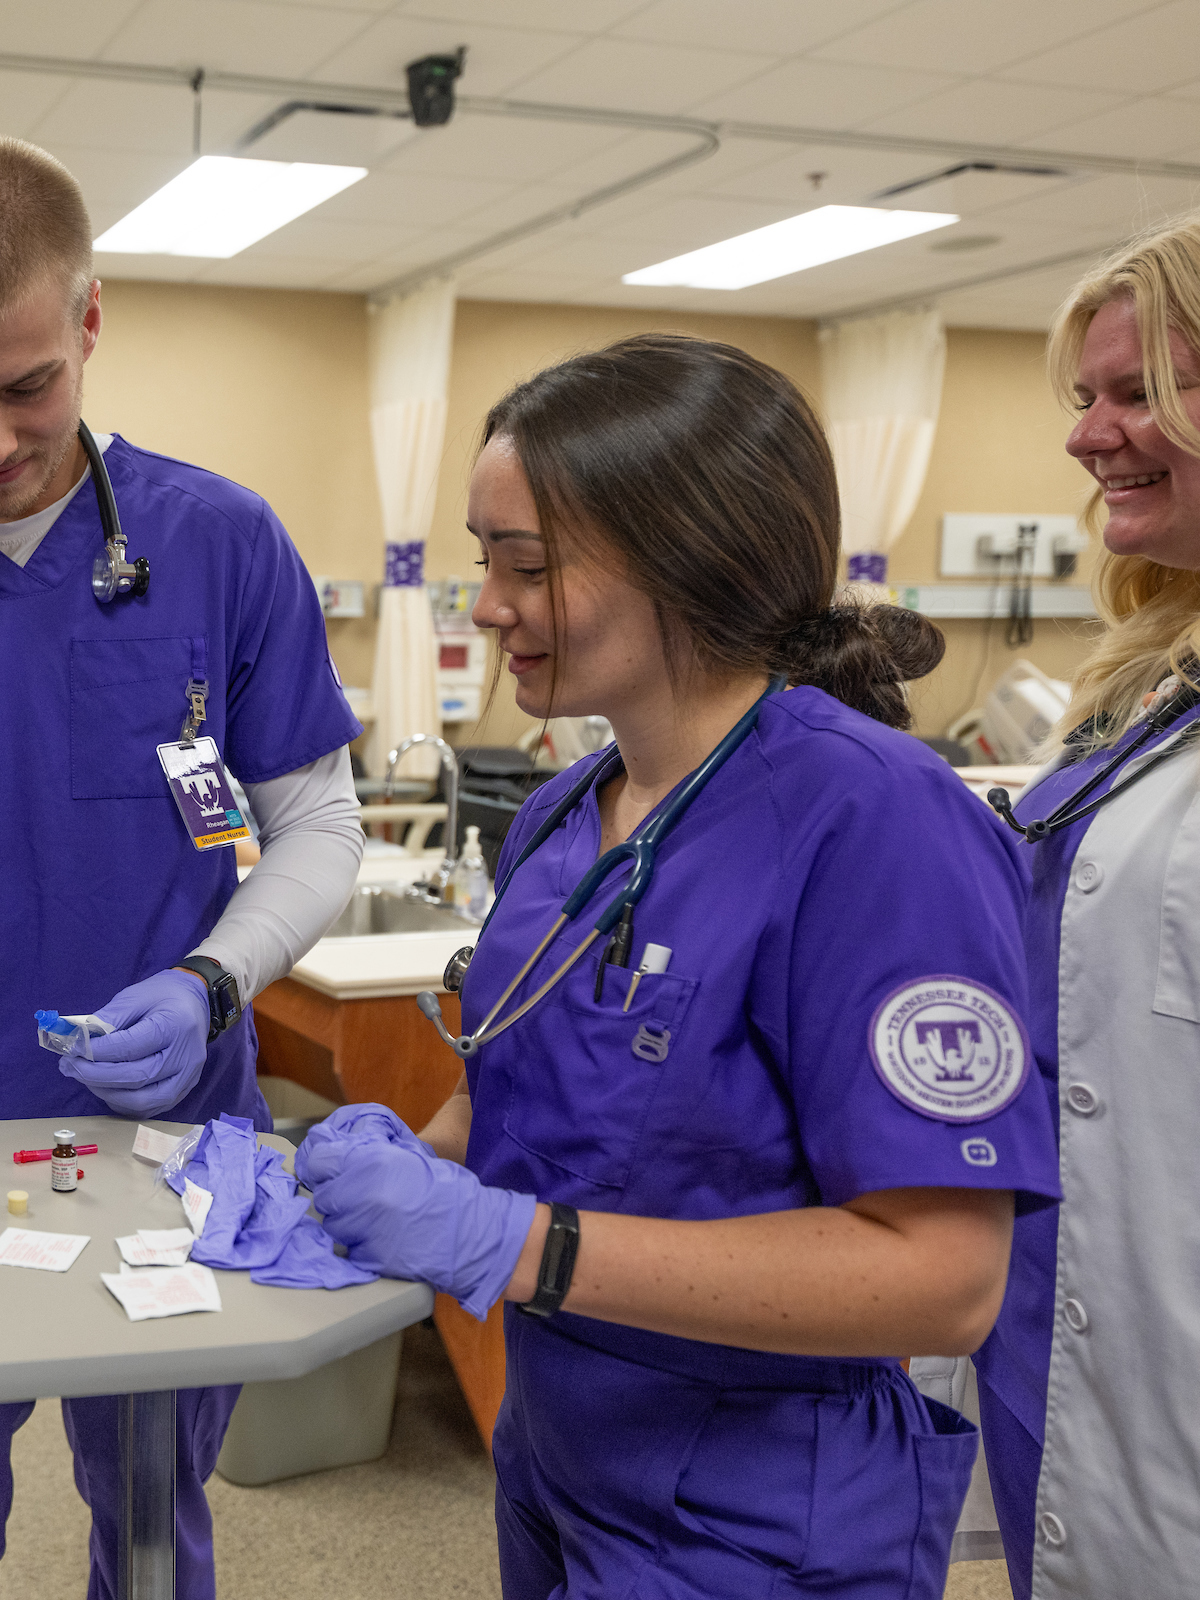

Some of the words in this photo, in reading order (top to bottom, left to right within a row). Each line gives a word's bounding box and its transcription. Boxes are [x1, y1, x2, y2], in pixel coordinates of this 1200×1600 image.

[201, 834, 227, 845] Student
[227, 830, 246, 839] Nurse
[887, 989, 968, 1031] TENNESSEE
[971, 996, 1007, 1029] TECH
